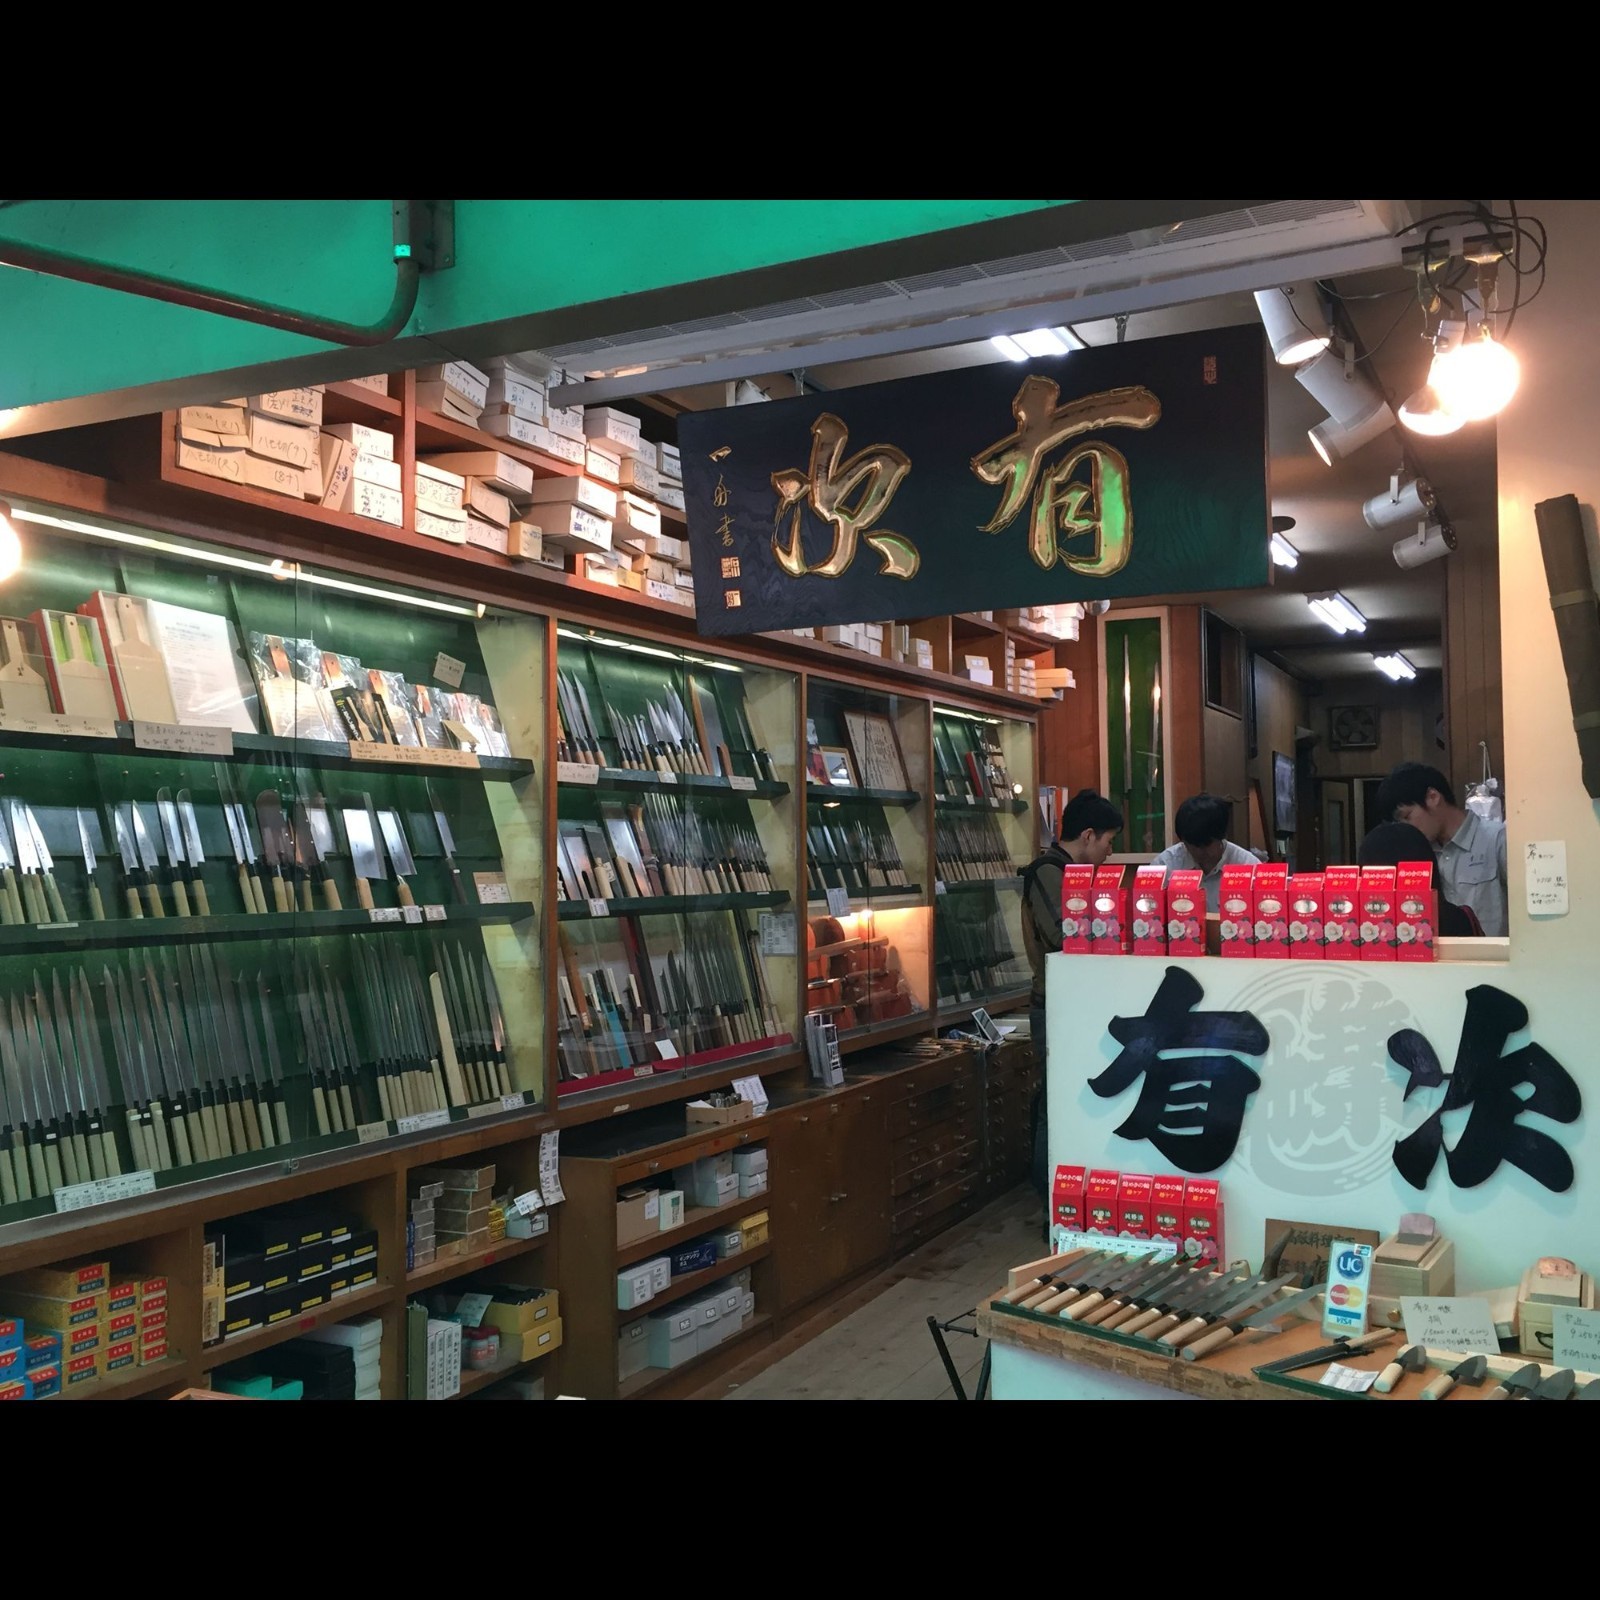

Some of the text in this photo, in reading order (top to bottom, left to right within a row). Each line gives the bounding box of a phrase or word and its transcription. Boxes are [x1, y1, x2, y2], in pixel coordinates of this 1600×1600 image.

[770, 374, 1162, 581] 有次
[1088, 965, 1582, 1193] 有次
[1339, 1256, 1362, 1273] UC
[1336, 1316, 1352, 1326] VISA
